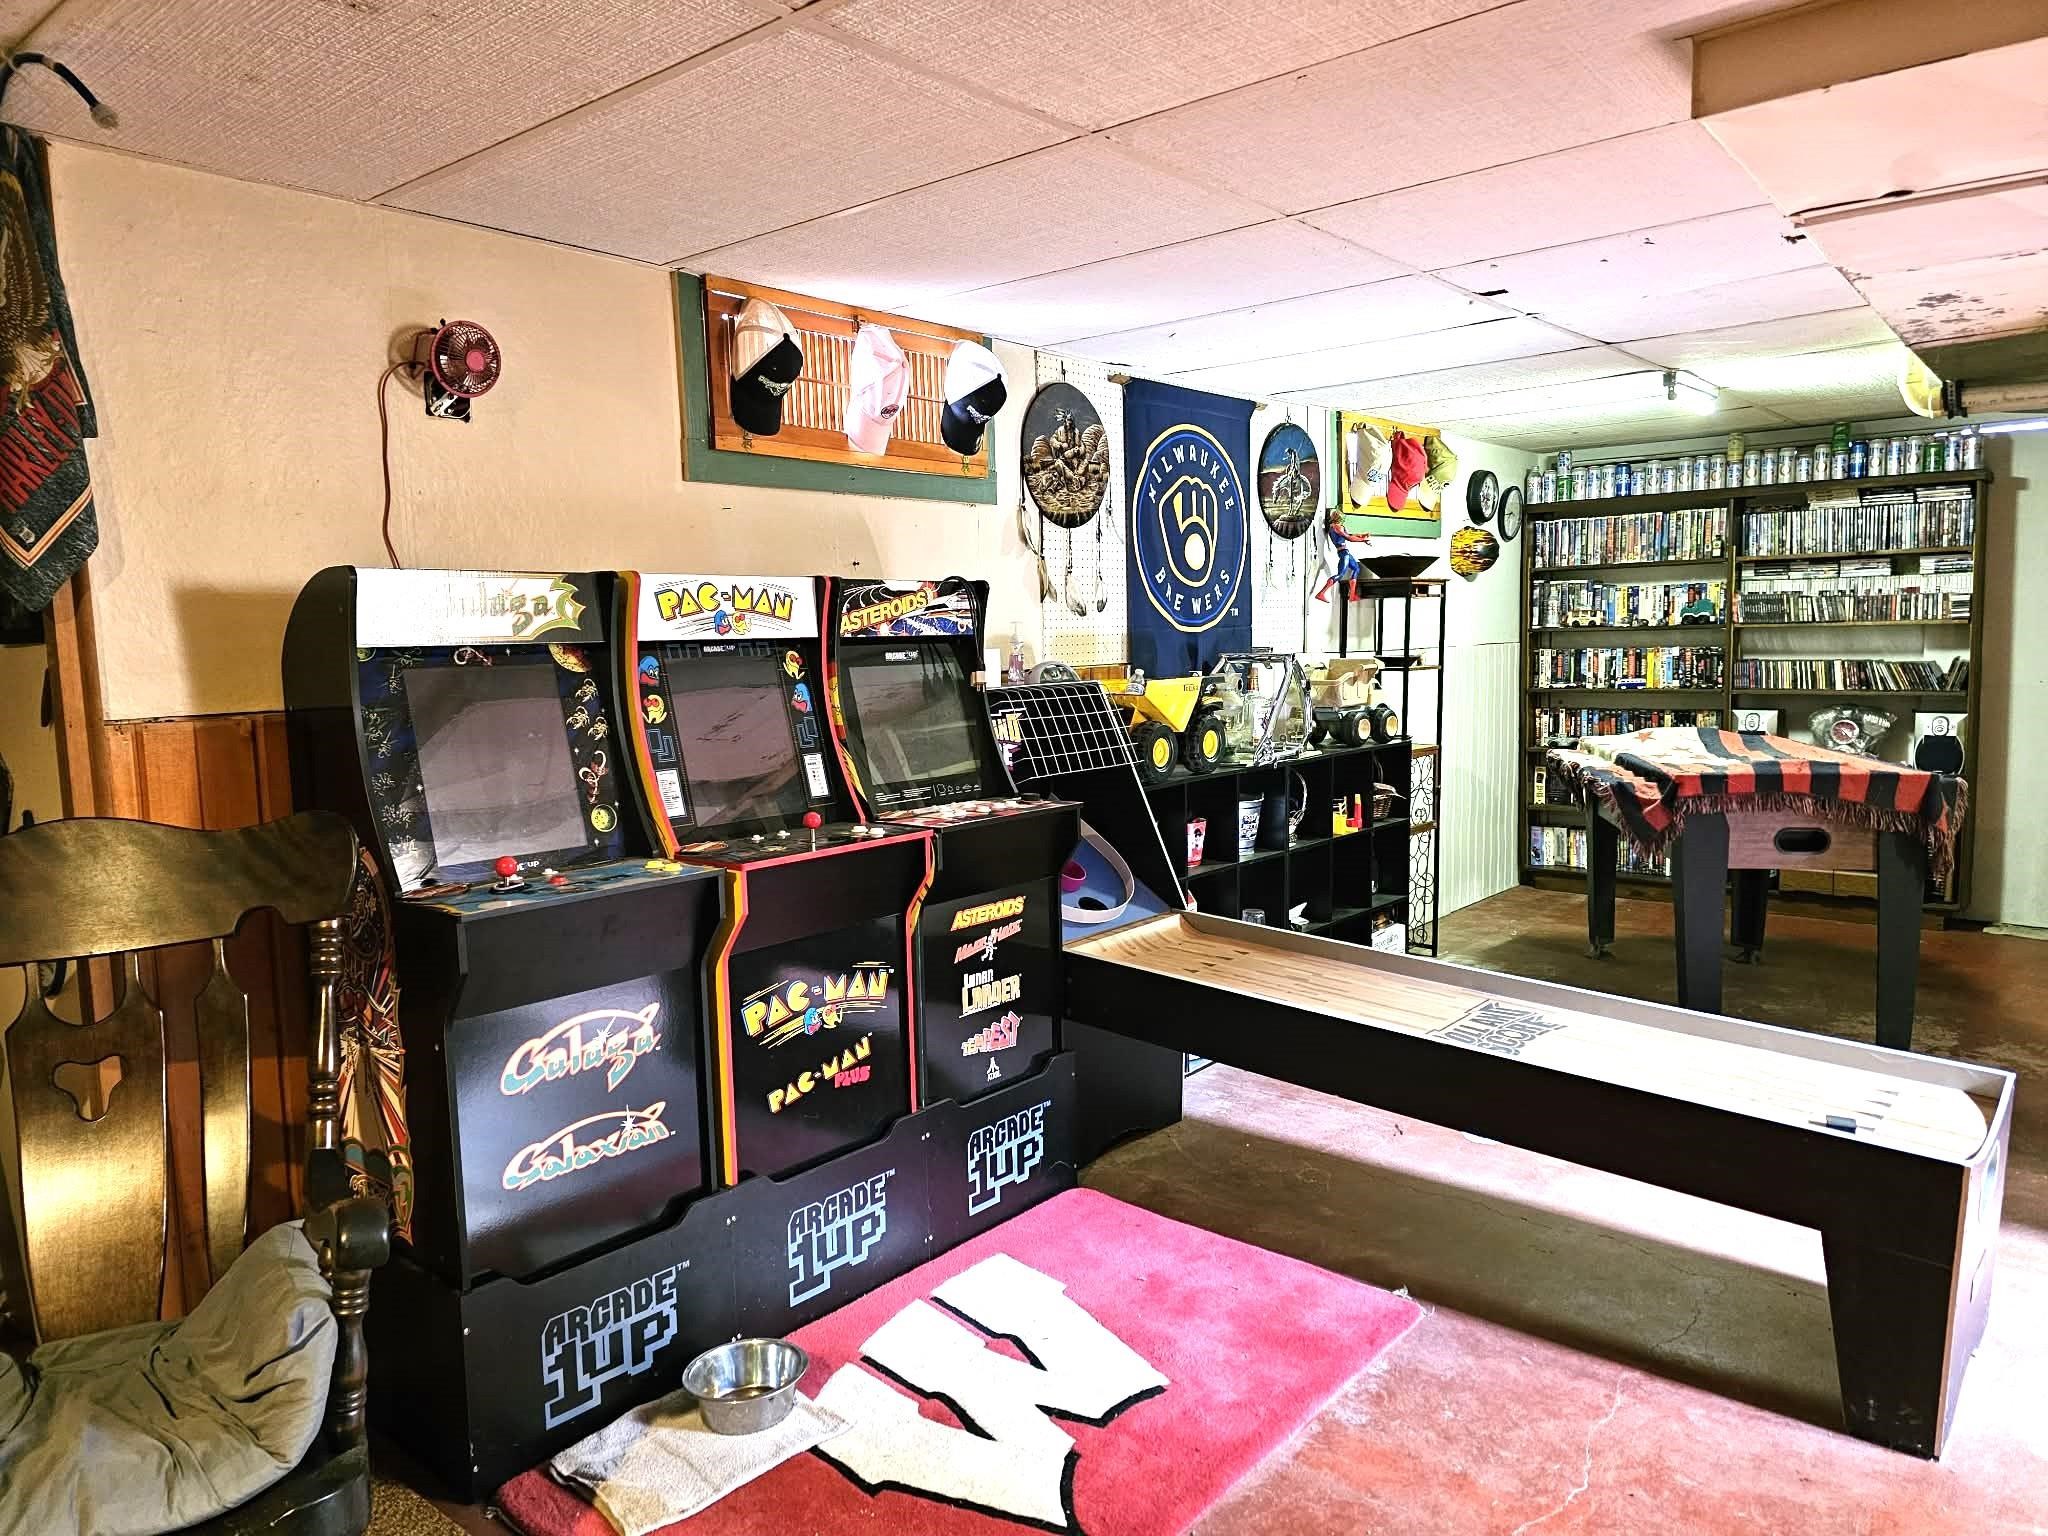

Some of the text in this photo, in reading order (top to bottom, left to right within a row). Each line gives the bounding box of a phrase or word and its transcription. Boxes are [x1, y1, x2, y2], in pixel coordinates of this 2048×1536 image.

[1148, 444, 1235, 511] MILWAUKEE
[654, 581, 793, 622] PAC-MAN
[840, 590, 929, 635] ASTEROIDS
[1155, 566, 1230, 615] BREWERS
[950, 895, 1025, 932] ASTEROIDS
[741, 969, 889, 1037] PAC-MAN
[961, 974, 1021, 1016] LANDER
[500, 1002, 662, 1096] Galaga
[961, 1010, 1020, 1056] TEMPEST
[767, 1035, 872, 1114] PAC-MAN
[834, 1065, 871, 1089] PLUS
[502, 1100, 672, 1191] Galaxian
[967, 1104, 1044, 1161] ARCADE
[968, 1134, 1044, 1217] 1UP
[787, 1173, 887, 1246] ARCADE
[788, 1205, 887, 1308] 1UP
[541, 1265, 677, 1358] ARCADE
[543, 1308, 678, 1431] 1UP
